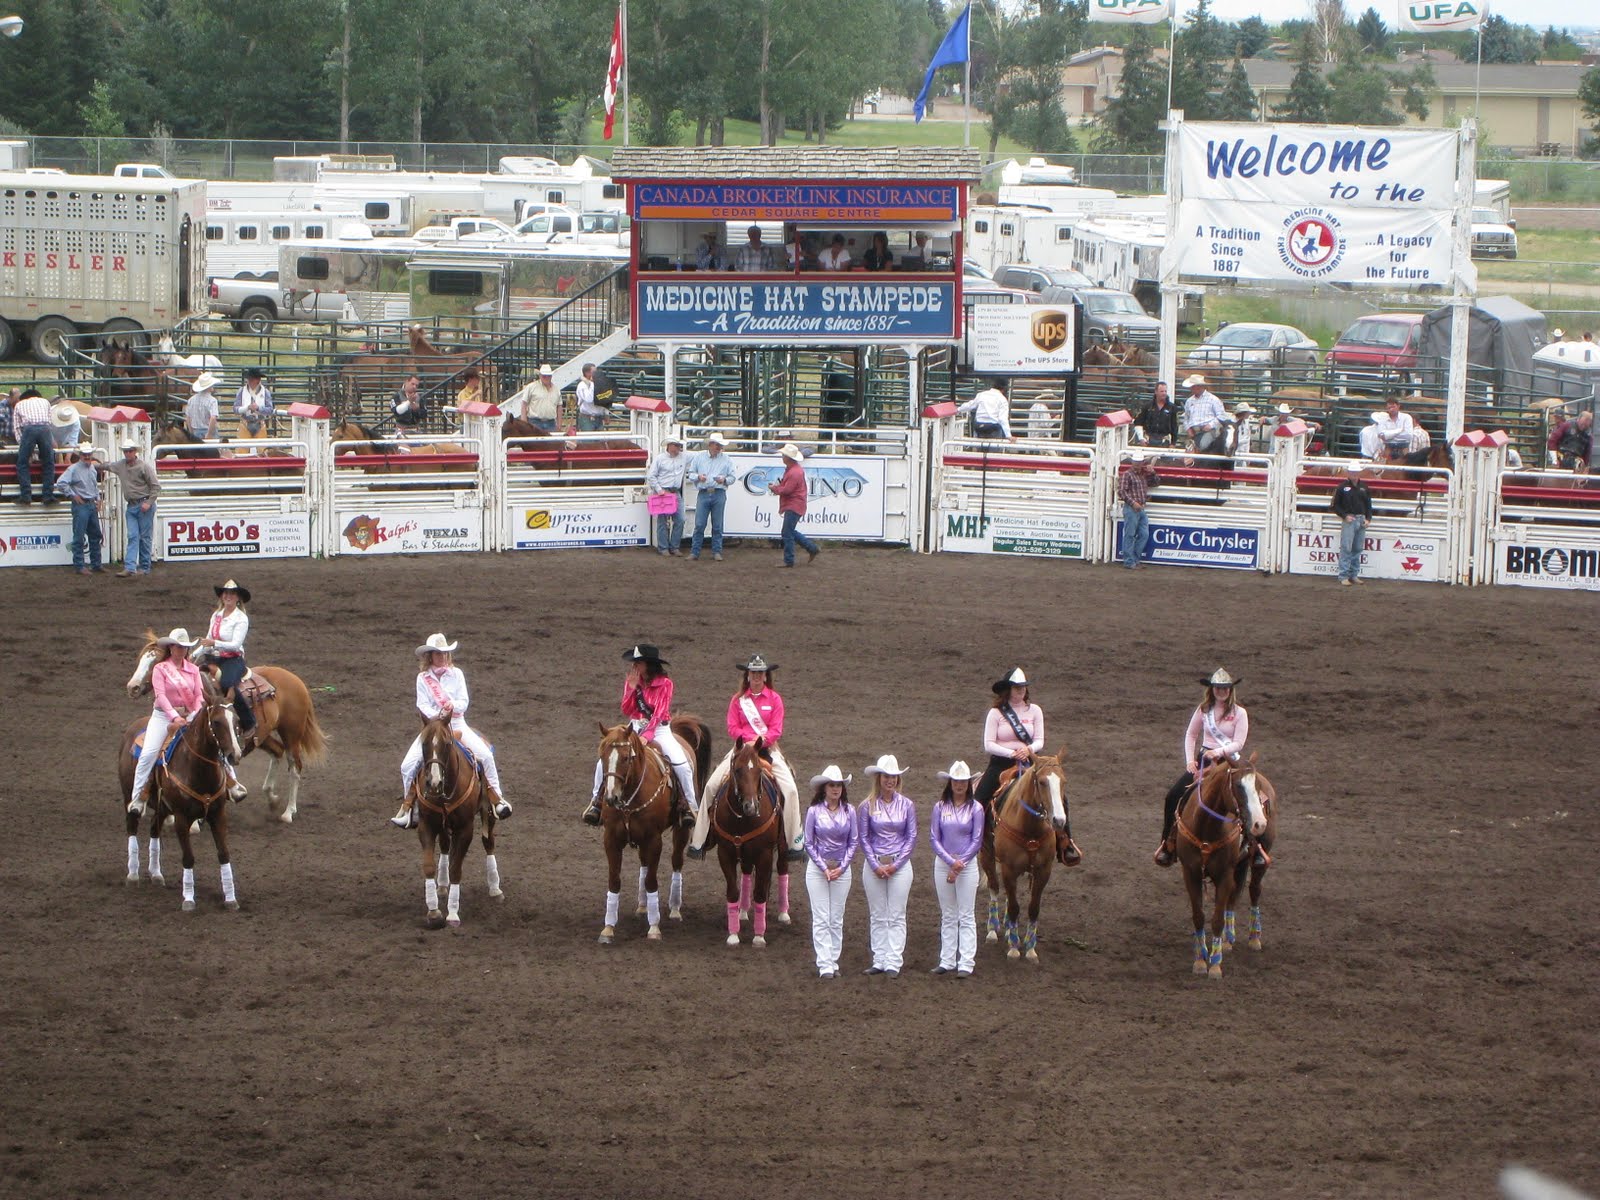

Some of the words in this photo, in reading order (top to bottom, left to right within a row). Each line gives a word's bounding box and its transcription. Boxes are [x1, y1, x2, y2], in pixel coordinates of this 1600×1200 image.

[1409, 2, 1477, 21] UFA
[1206, 134, 1391, 180] Welcome
[639, 188, 718, 203] CANADA
[723, 188, 841, 204] BROKERLINK
[846, 189, 952, 205] INSURANCE
[1329, 181, 1359, 199] to
[1375, 182, 1425, 202] the
[712, 208, 756, 217] CEDAR
[765, 208, 818, 218] SQUARE
[828, 208, 880, 218] CENTRE
[1283, 207, 1323, 227] MEDICINE
[1325, 213, 1341, 228] HAT
[1196, 225, 1203, 238] A
[1209, 226, 1261, 241] Tradition
[1390, 234, 1432, 248] Legacy
[1211, 243, 1243, 256] Since
[1390, 250, 1407, 262] for
[3, 252, 126, 271] KESLER
[1317, 238, 1346, 277] STAMPEDE
[1213, 259, 1240, 272] 1887
[1366, 266, 1385, 278] the
[1391, 267, 1430, 279] Future
[646, 286, 754, 312] MEDICINE
[764, 286, 809, 312] HAT
[821, 286, 942, 312] STAMPEDE
[711, 312, 729, 332] A
[734, 312, 822, 334] Tradition
[824, 315, 864, 331] since
[862, 315, 898, 331] 1887
[743, 469, 863, 498] CINO
[525, 510, 593, 530] Cypress
[755, 506, 771, 529] by
[993, 517, 1024, 526] Medicine
[1027, 519, 1039, 527] Hat
[1041, 519, 1069, 529] Feeding
[168, 520, 260, 543] Plato's
[374, 519, 418, 545] Ralph's
[423, 528, 469, 539] TEXAS
[564, 522, 638, 535] Insurance
[947, 514, 991, 539] MHF
[996, 529, 1025, 537] Livestock
[1030, 531, 1054, 539] Auction
[16, 536, 37, 545] CHAT
[39, 536, 49, 544] TV
[402, 540, 418, 550] Bar
[432, 539, 479, 550] Steakhouse
[993, 538, 1015, 546] Regular
[1033, 540, 1048, 548] Every
[1050, 541, 1081, 550] Wednesday
[1152, 528, 1185, 550] City
[1189, 531, 1256, 552] Chrysler
[1297, 534, 1334, 548] HAT
[170, 545, 207, 554] SUPERIOR
[208, 544, 240, 553] ROOFING
[242, 544, 258, 552] LTD.
[1309, 550, 1368, 565] SERVE
[1505, 573, 1579, 582] MECHANICAL
